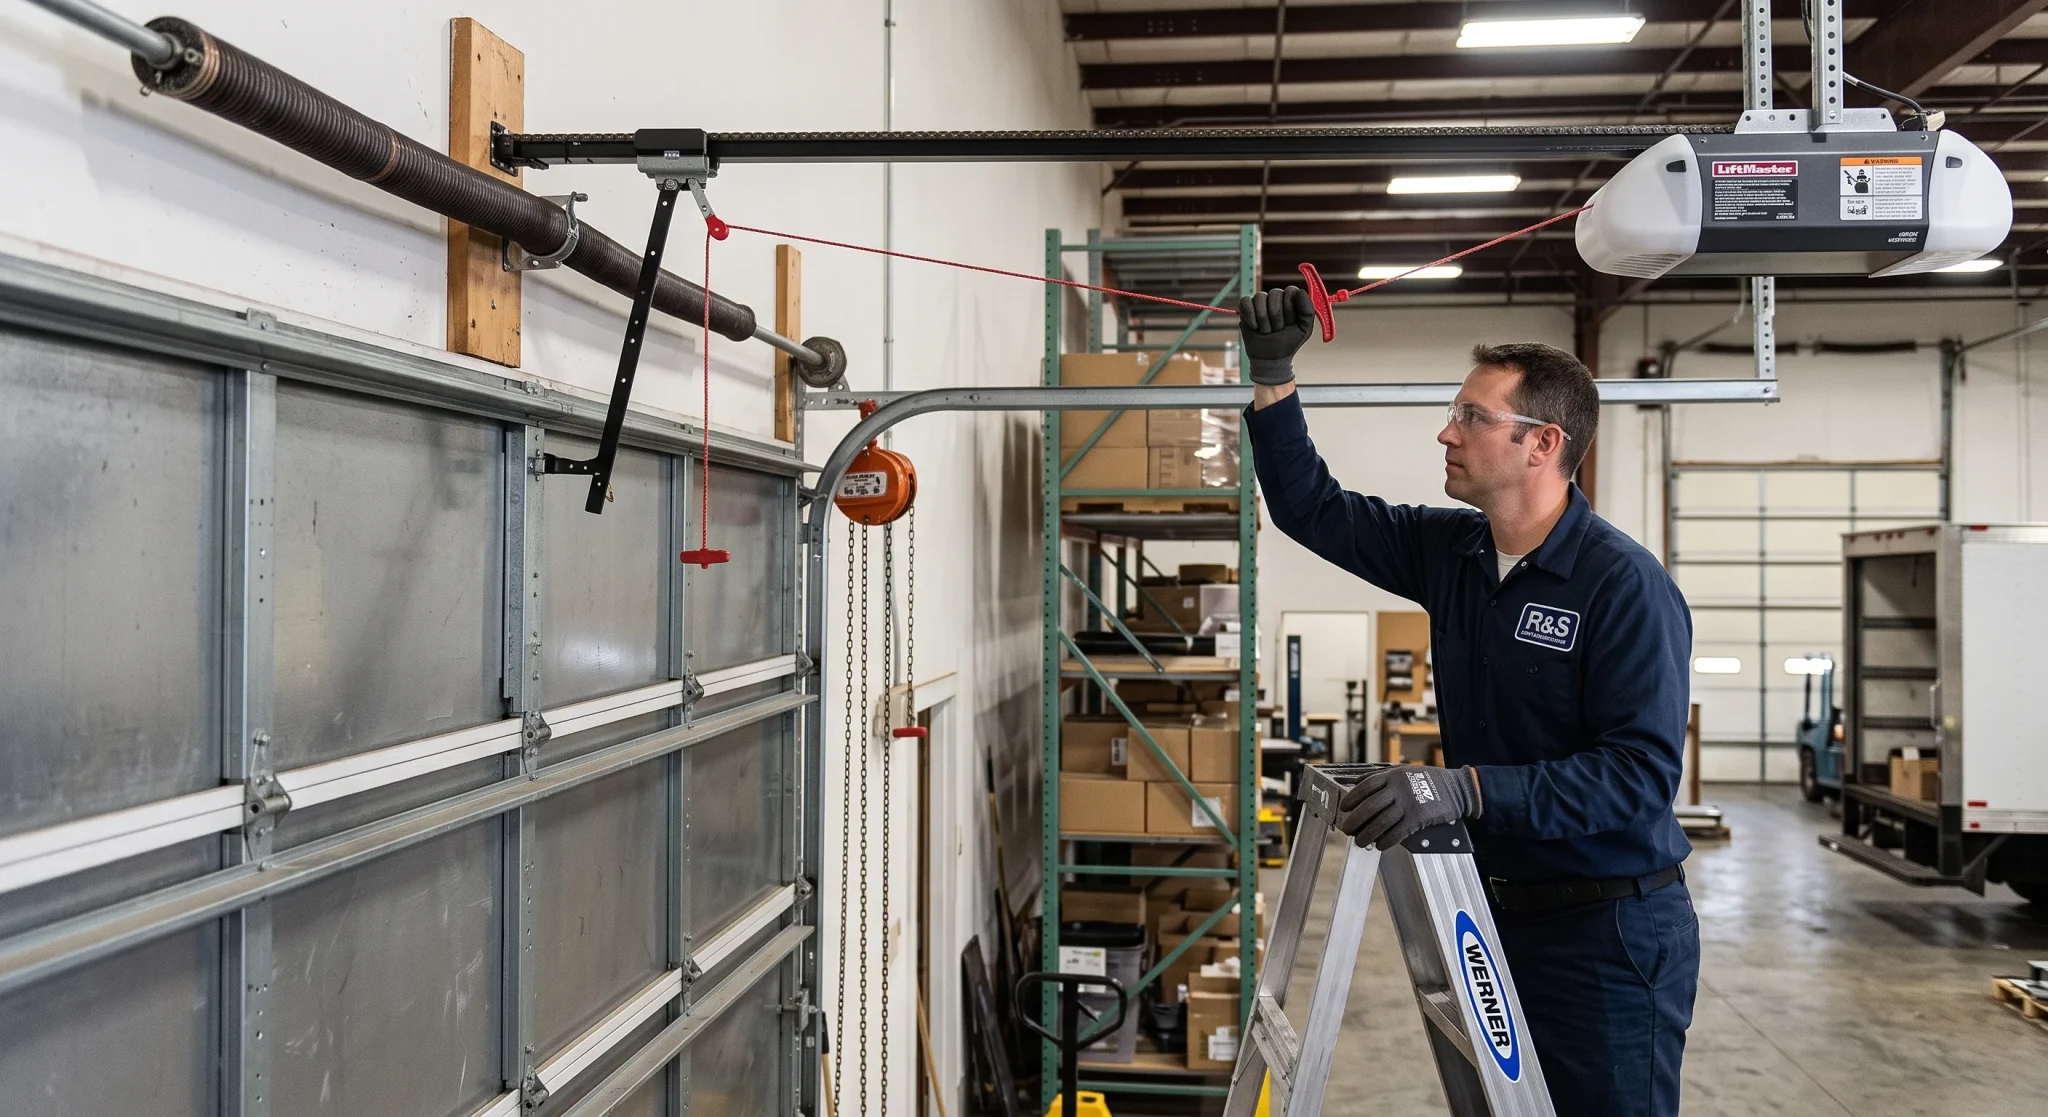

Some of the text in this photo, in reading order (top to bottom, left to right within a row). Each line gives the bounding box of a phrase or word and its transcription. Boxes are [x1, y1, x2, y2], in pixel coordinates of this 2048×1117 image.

[1717, 164, 1793, 174] LiftMaster
[1525, 610, 1571, 637] R&S
[1465, 943, 1511, 1048] WERNER
